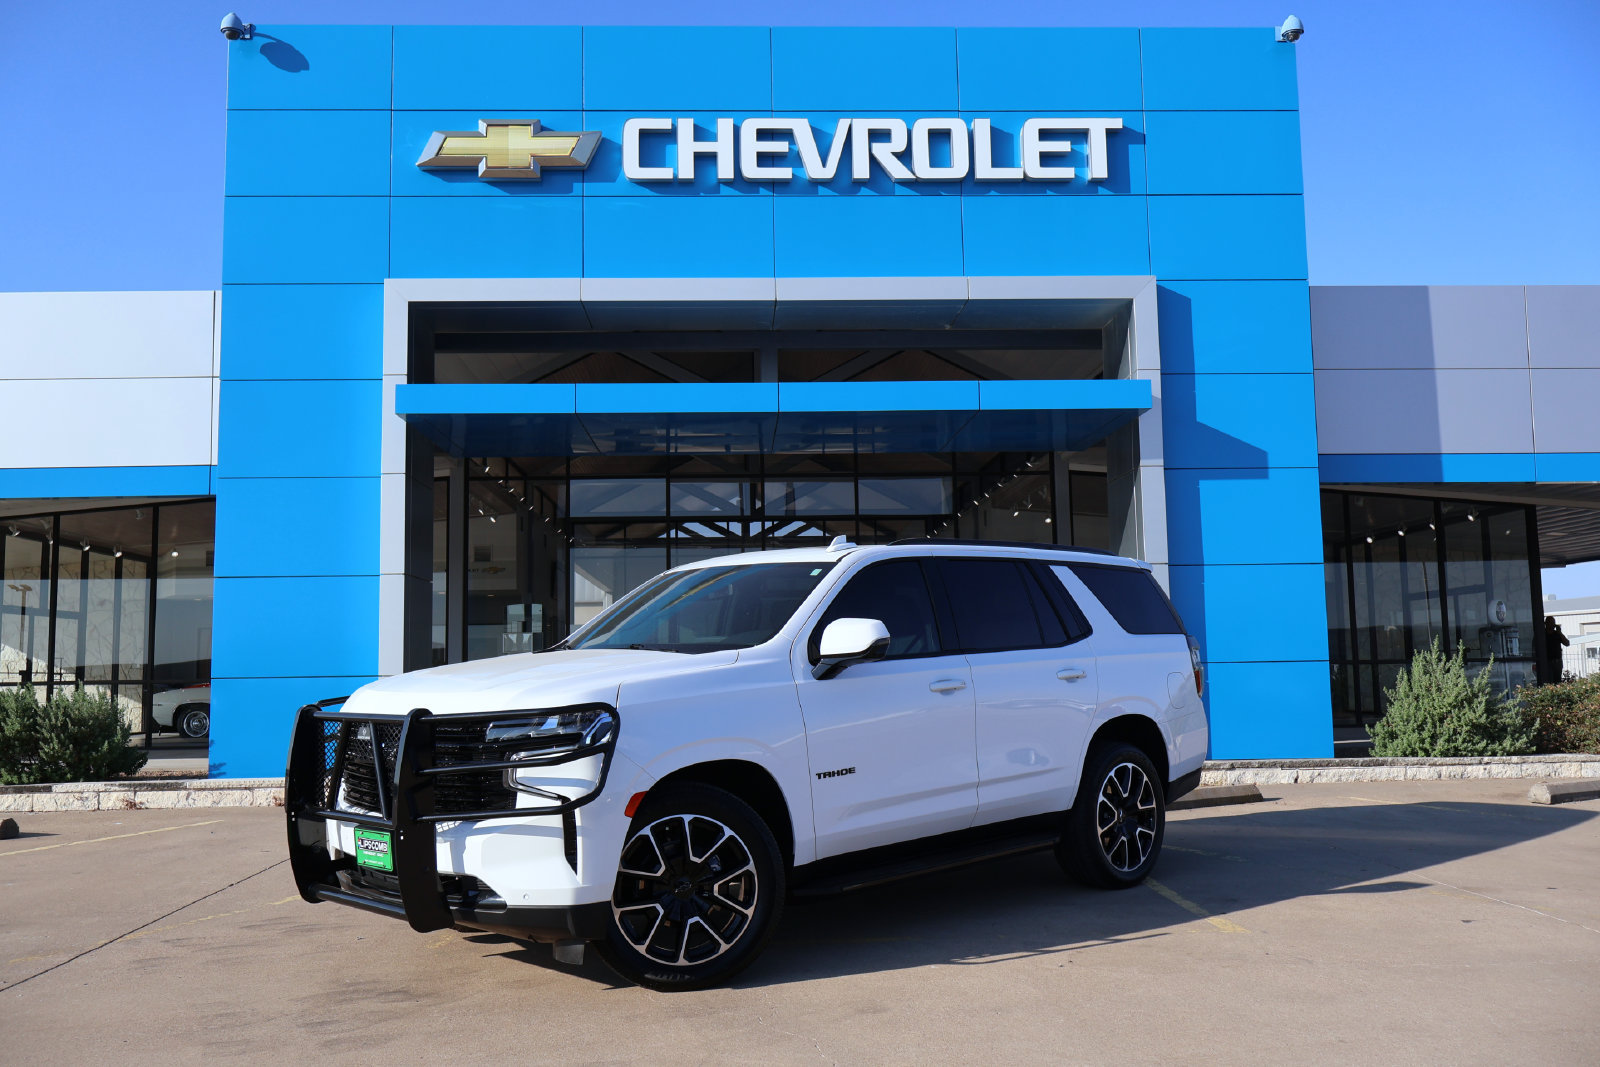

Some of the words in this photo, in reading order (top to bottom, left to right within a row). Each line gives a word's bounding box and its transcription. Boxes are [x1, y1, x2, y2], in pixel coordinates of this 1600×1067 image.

[622, 117, 1123, 183] CHEVROLET
[815, 766, 856, 780] TAHOE
[359, 838, 388, 852] LIPSCOMB
